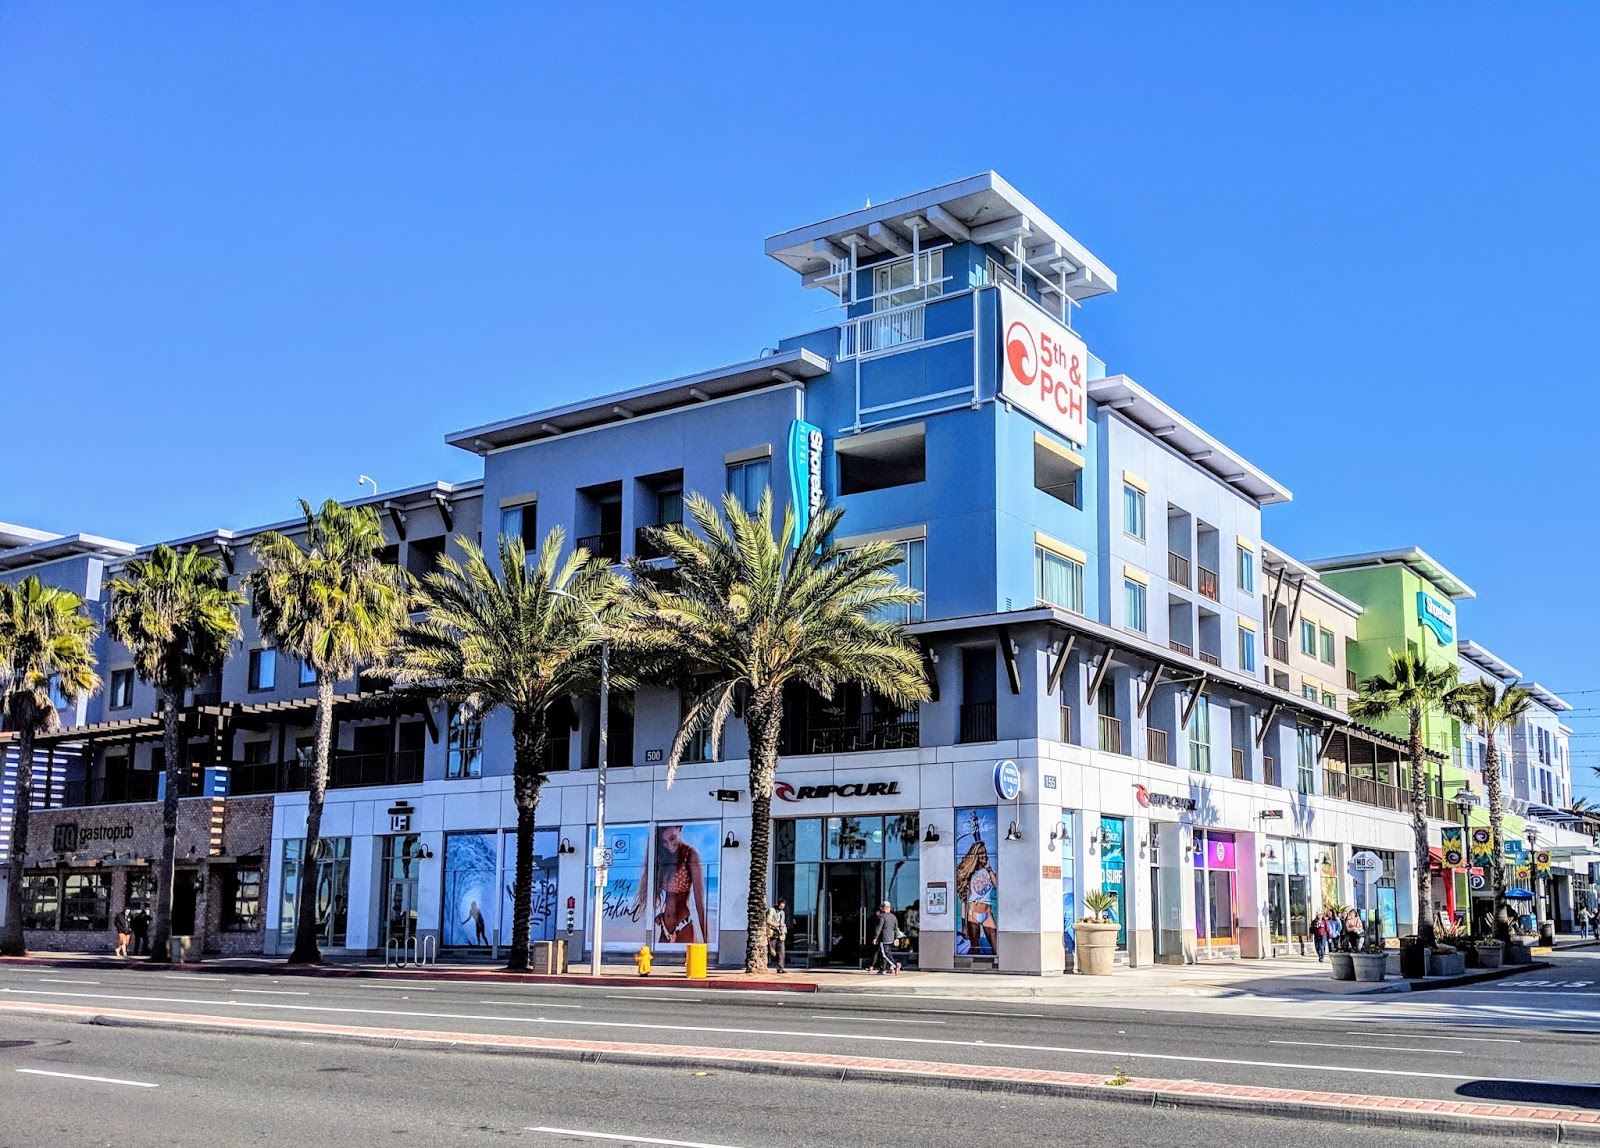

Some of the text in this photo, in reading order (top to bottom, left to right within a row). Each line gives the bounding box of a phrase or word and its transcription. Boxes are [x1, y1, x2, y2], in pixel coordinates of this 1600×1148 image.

[1041, 332, 1081, 389] 5th &
[1041, 369, 1082, 425] PCH
[810, 430, 824, 535] Shorebre
[647, 751, 661, 761] 500
[54, 822, 134, 850] HQ gastropub
[612, 878, 632, 900] My
[1106, 869, 1123, 884] SURF
